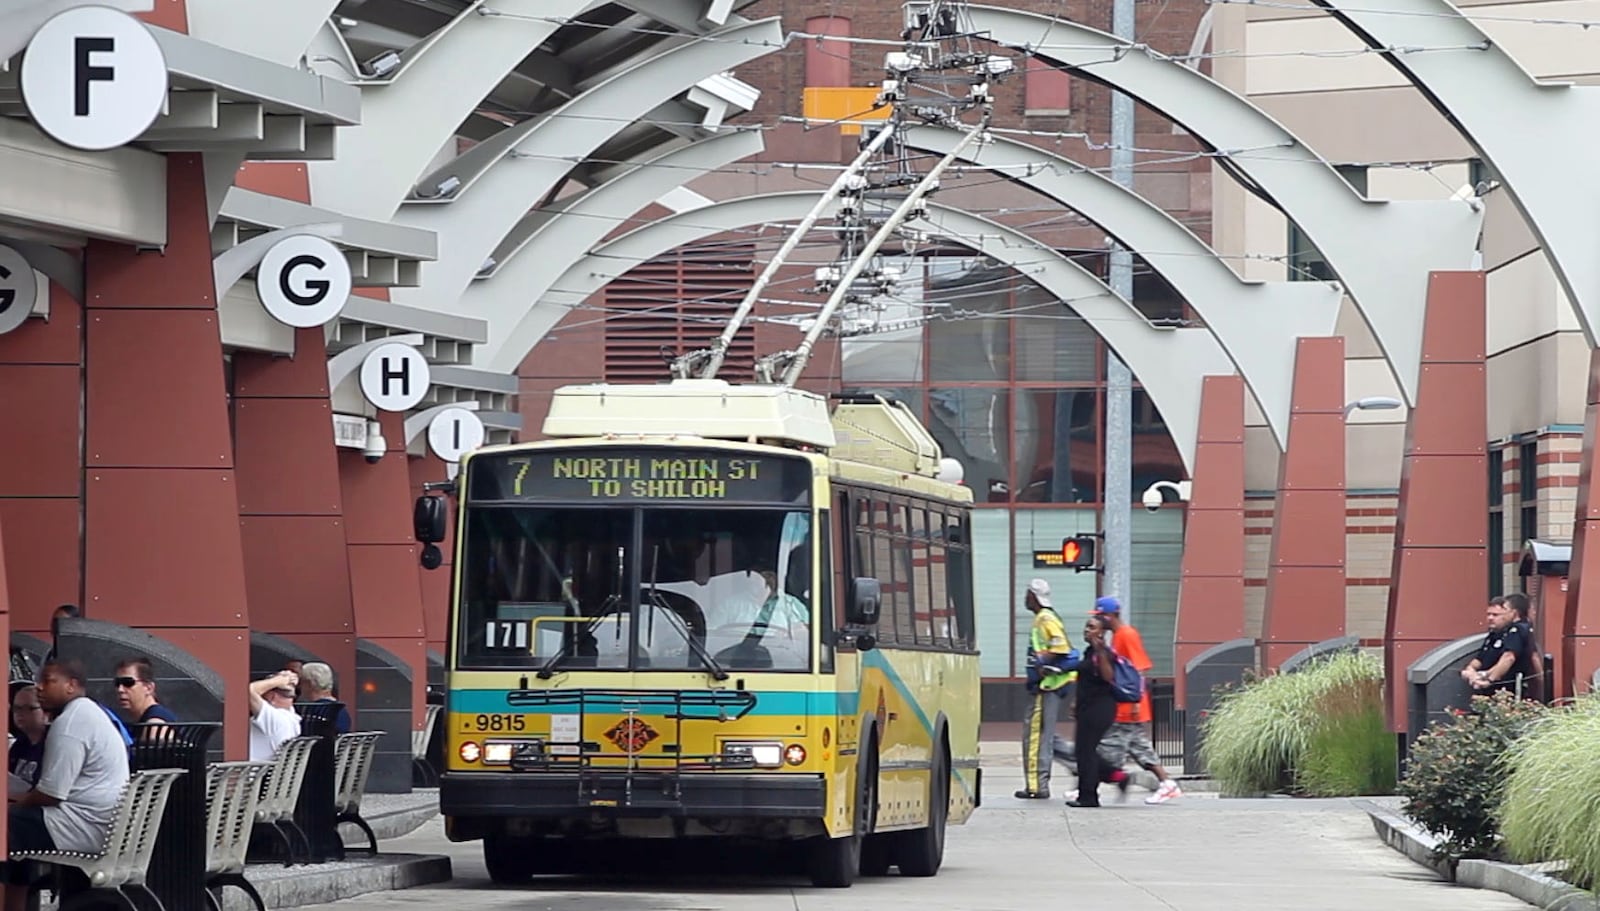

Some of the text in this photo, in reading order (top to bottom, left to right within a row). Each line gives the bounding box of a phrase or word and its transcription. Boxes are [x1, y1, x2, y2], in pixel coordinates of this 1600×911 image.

[75, 37, 115, 117] F
[279, 255, 330, 306] G
[381, 357, 410, 396] H
[453, 419, 460, 450] I
[508, 458, 531, 496] 7
[553, 458, 761, 480] NORTH MAIN ST
[588, 479, 725, 498] TO SHILOH
[476, 714, 526, 731] 9815
